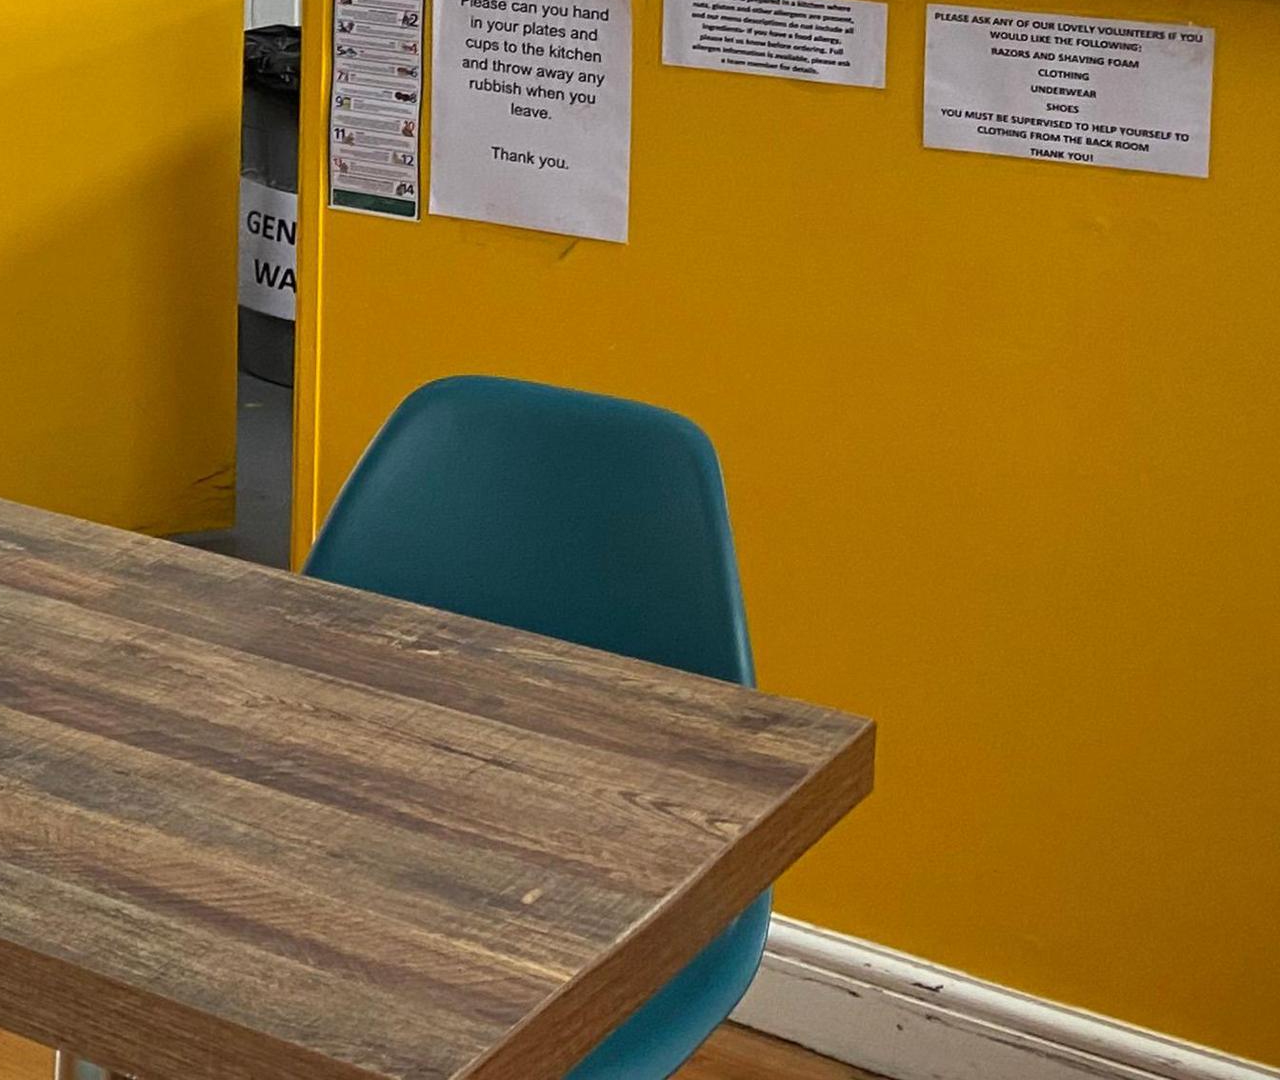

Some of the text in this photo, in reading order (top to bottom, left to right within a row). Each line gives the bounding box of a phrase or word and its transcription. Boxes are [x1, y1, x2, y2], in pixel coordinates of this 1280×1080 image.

[511, 1, 537, 14] can
[542, 5, 568, 18] you
[573, 5, 609, 21] hand
[752, 7, 772, 15] other
[797, 0, 825, 10] kitchen
[827, 4, 850, 12] where
[410, 14, 418, 27] 2
[470, 16, 598, 41] in your plates and
[934, 12, 1204, 43] PLEASE ASK ANY OF OUR LOVELY VOLUNTEERS IF YOU
[465, 38, 602, 63] cups to the kitchen
[990, 31, 1142, 52] WOULD LIKE THE FOLLOWING:
[991, 47, 1140, 69] RAZORS AND SHAVING FOAM
[462, 58, 605, 87] and throw away any
[1038, 68, 1090, 81] CLOTHING
[469, 78, 596, 105] rubbish when you
[1030, 85, 1097, 98] UNDERWEAR
[336, 96, 344, 108] 9
[510, 102, 552, 119] leave.
[1046, 103, 1079, 114] SHOES
[334, 128, 345, 139] 11
[941, 108, 1190, 142] YOU MUST BE SUPERVISED TO HELP YOURSELF TO
[977, 126, 1149, 152] CLOTHING FROM THE BACK ROOM
[401, 154, 414, 166] 12
[491, 146, 569, 169] Thank you.
[1030, 148, 1094, 162] THANK YOU!
[247, 211, 296, 245] GEN
[255, 259, 297, 293] WA
